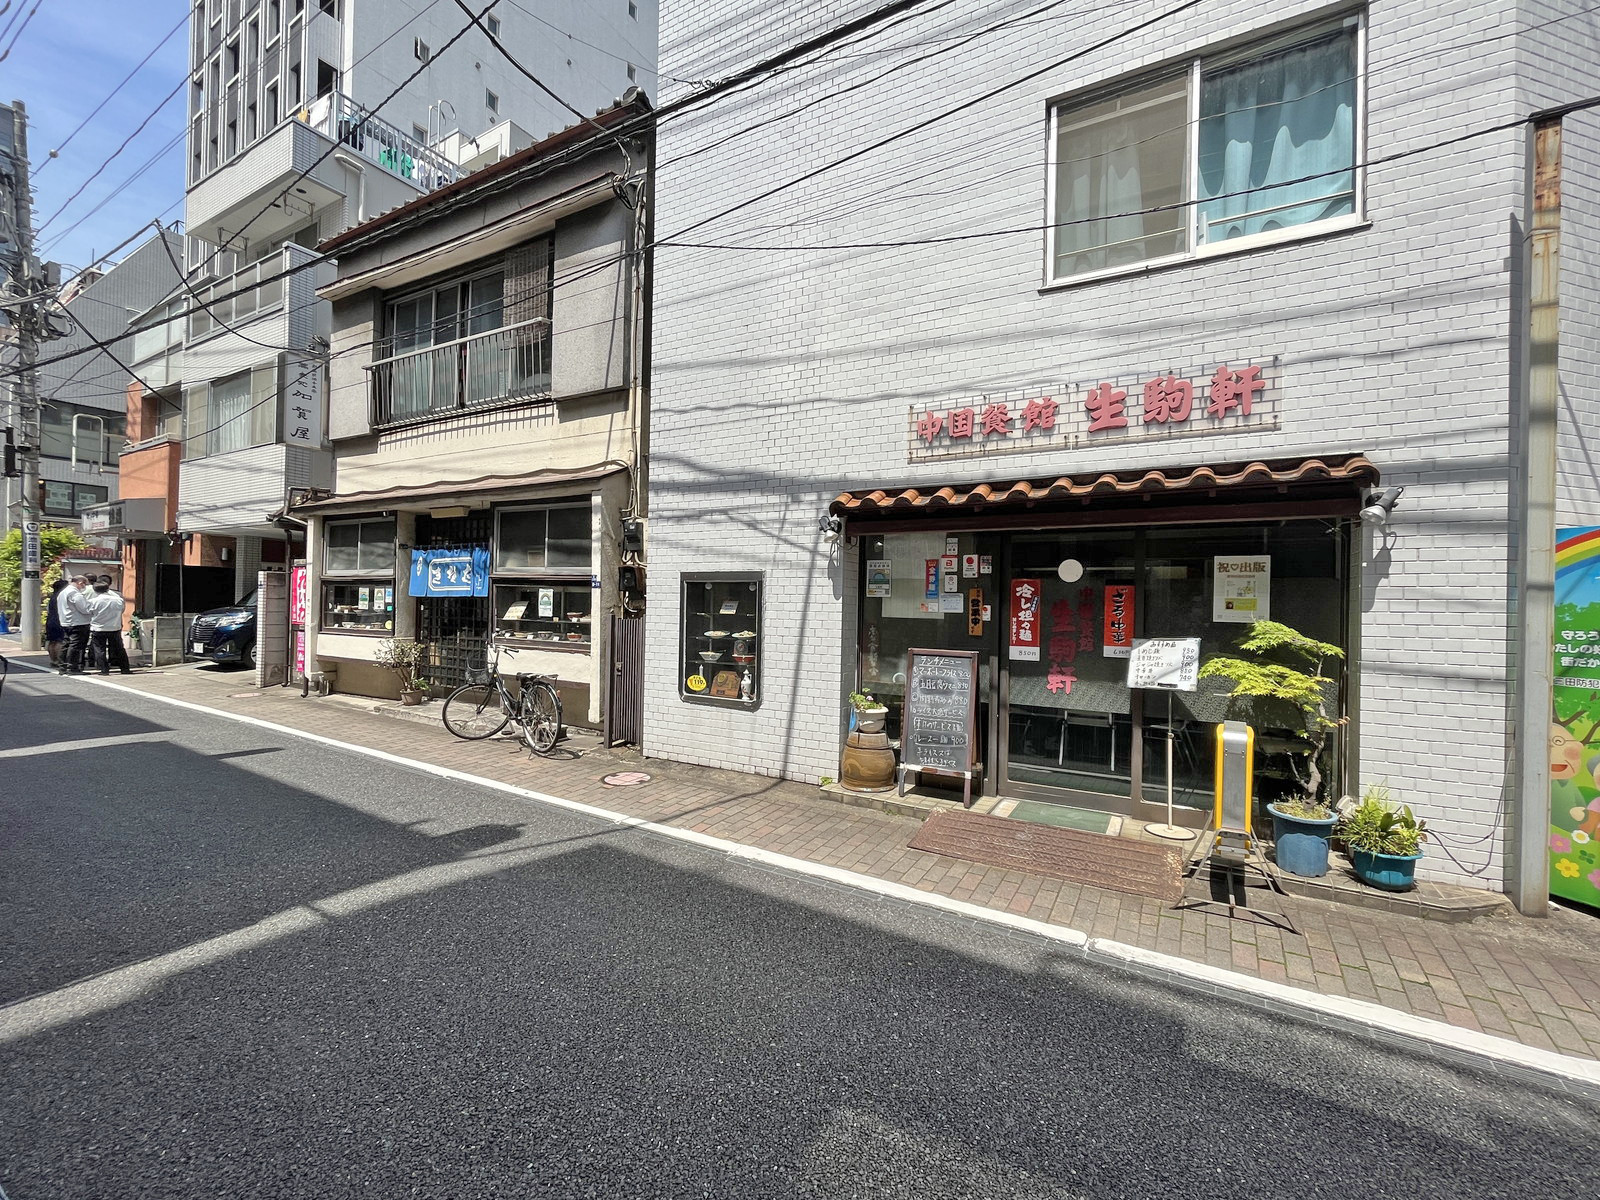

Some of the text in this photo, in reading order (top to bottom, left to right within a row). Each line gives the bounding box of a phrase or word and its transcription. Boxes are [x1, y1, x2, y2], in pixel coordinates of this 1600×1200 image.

[916, 364, 1266, 444] 中国餐館 生駒軒
[1561, 630, 1600, 641] 守ろう
[920, 656, 962, 666] ランチメニュー
